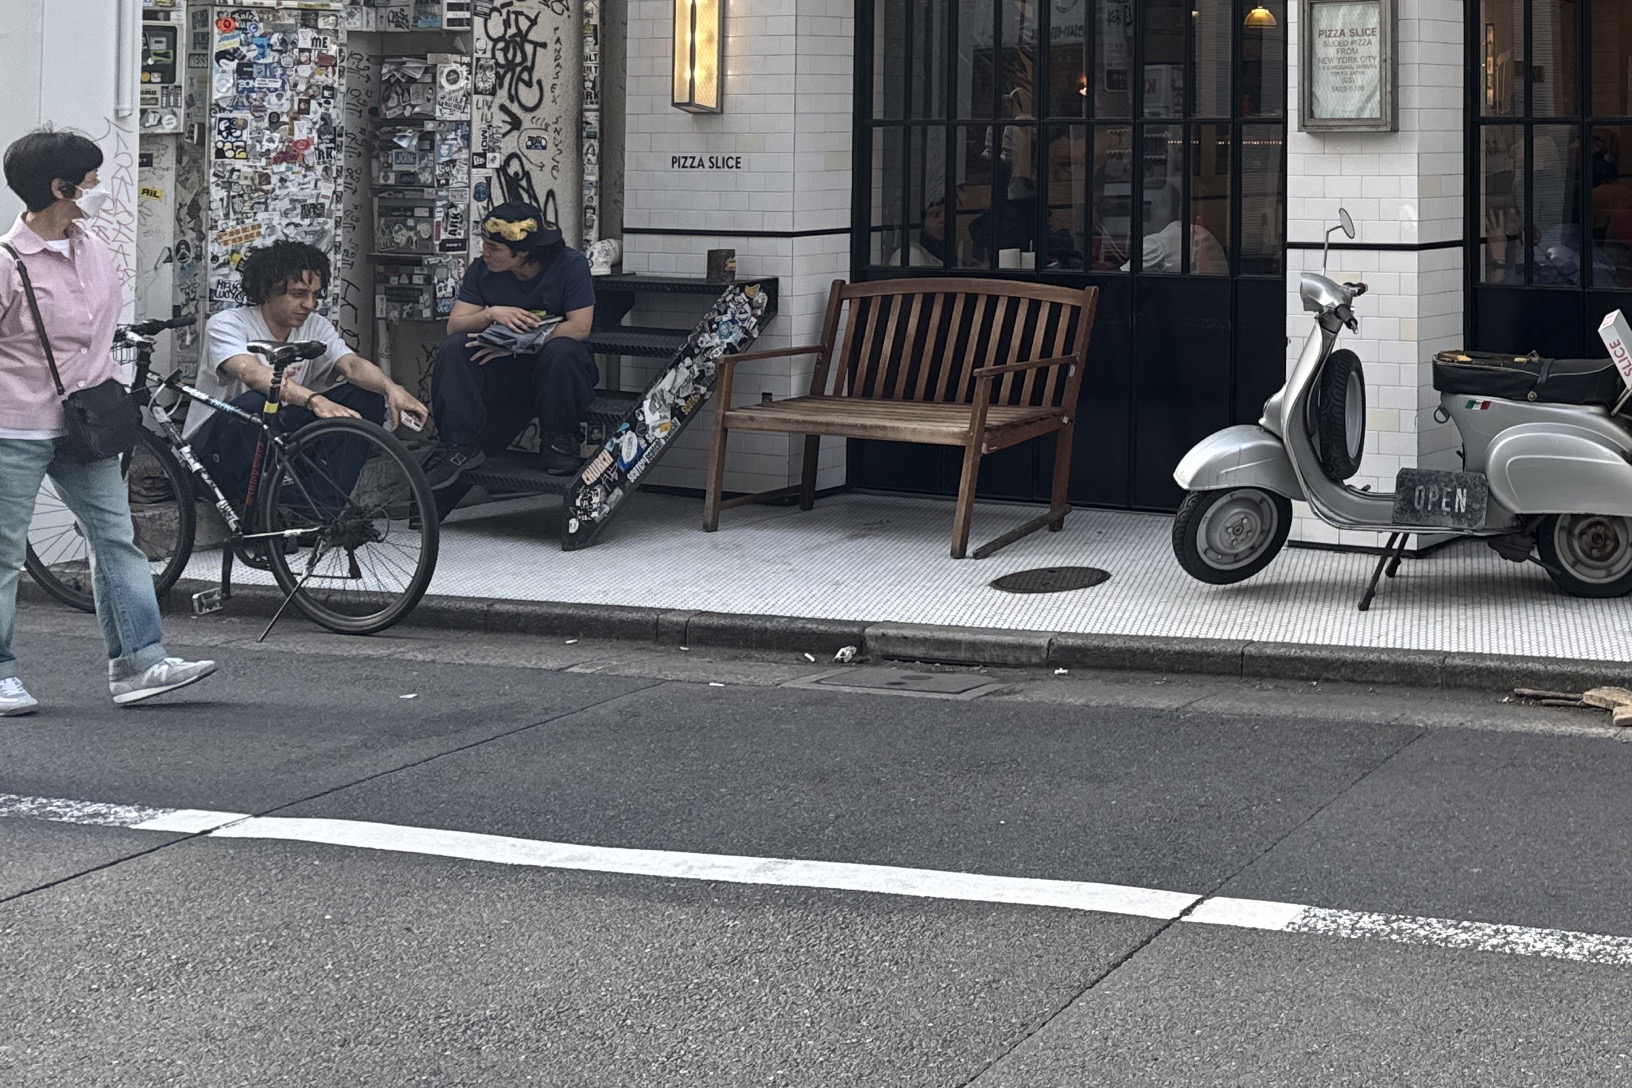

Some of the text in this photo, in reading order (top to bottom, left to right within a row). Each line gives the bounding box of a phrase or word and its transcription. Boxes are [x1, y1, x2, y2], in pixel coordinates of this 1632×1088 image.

[1318, 28, 1377, 38] PIZZA SLICE
[1323, 39, 1373, 48] SLICED PIZZA
[1318, 57, 1334, 65] NEW
[1337, 56, 1359, 64] YORK
[671, 156, 742, 170] PIZZA SLICE
[1414, 484, 1468, 513] OPEN
